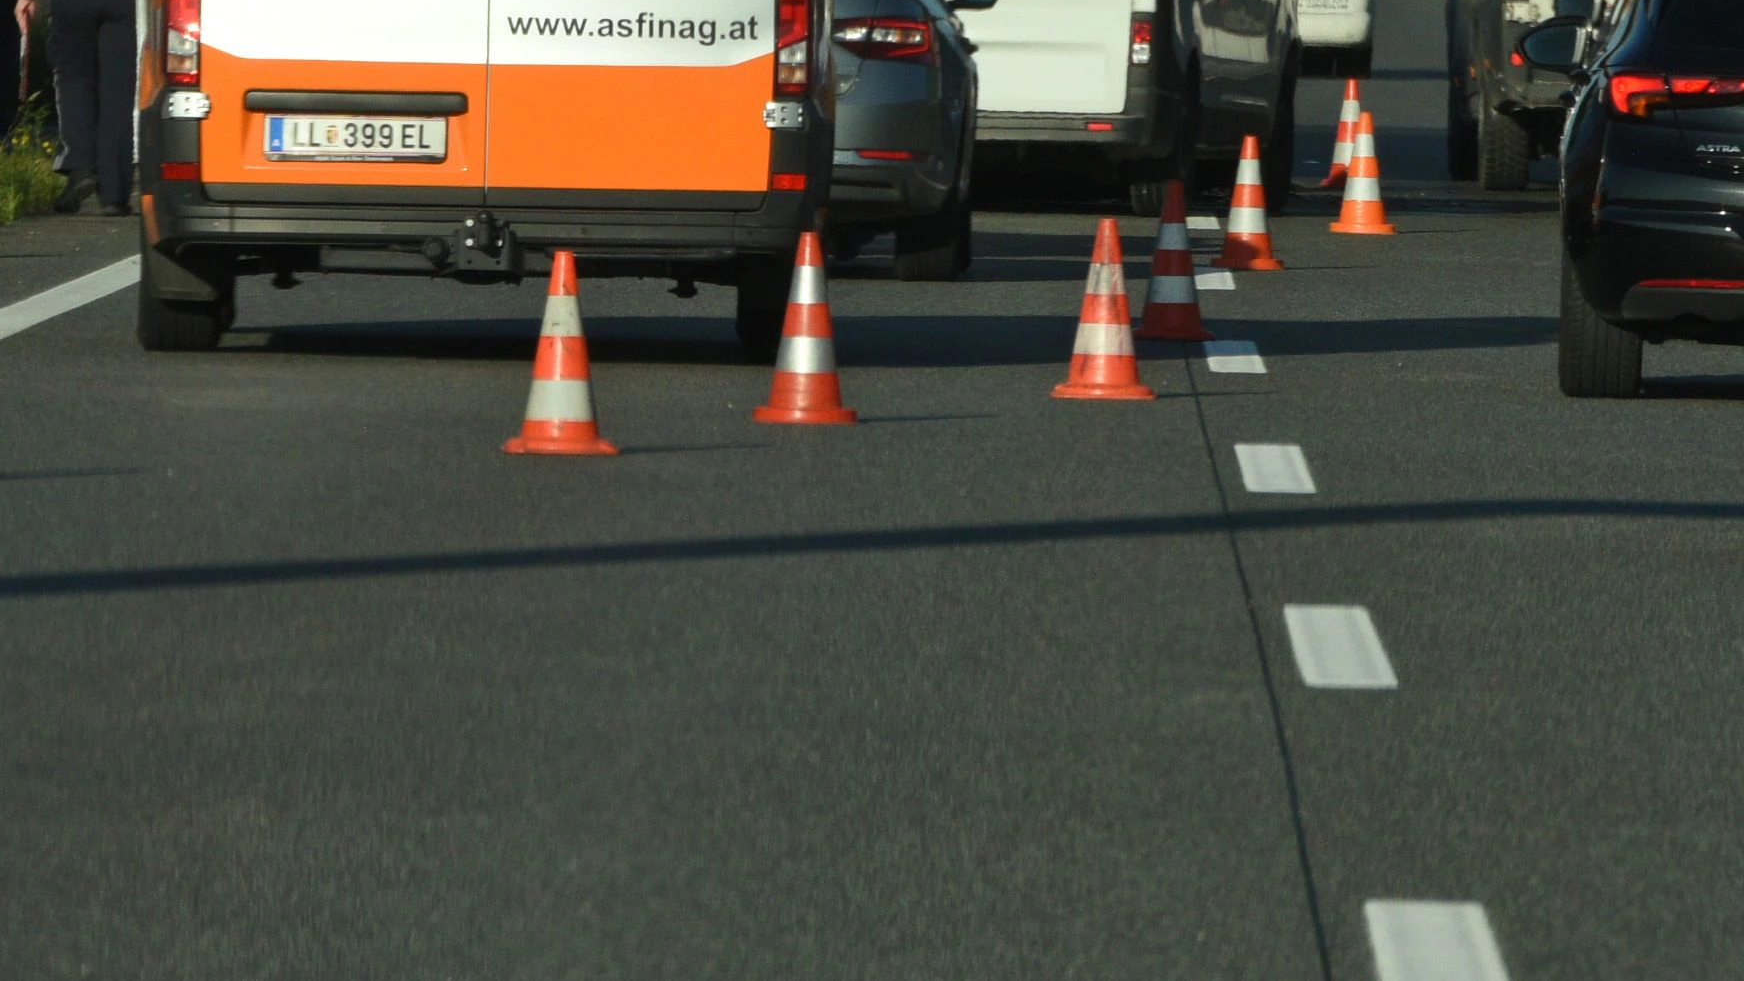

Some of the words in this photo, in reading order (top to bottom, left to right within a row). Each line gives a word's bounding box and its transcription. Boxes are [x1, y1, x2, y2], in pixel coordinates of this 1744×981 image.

[507, 11, 758, 46] www.asfinag.at
[293, 122, 321, 148] LL
[344, 122, 393, 149] 399
[401, 124, 431, 149] EL
[1696, 144, 1741, 153] ASTRA
